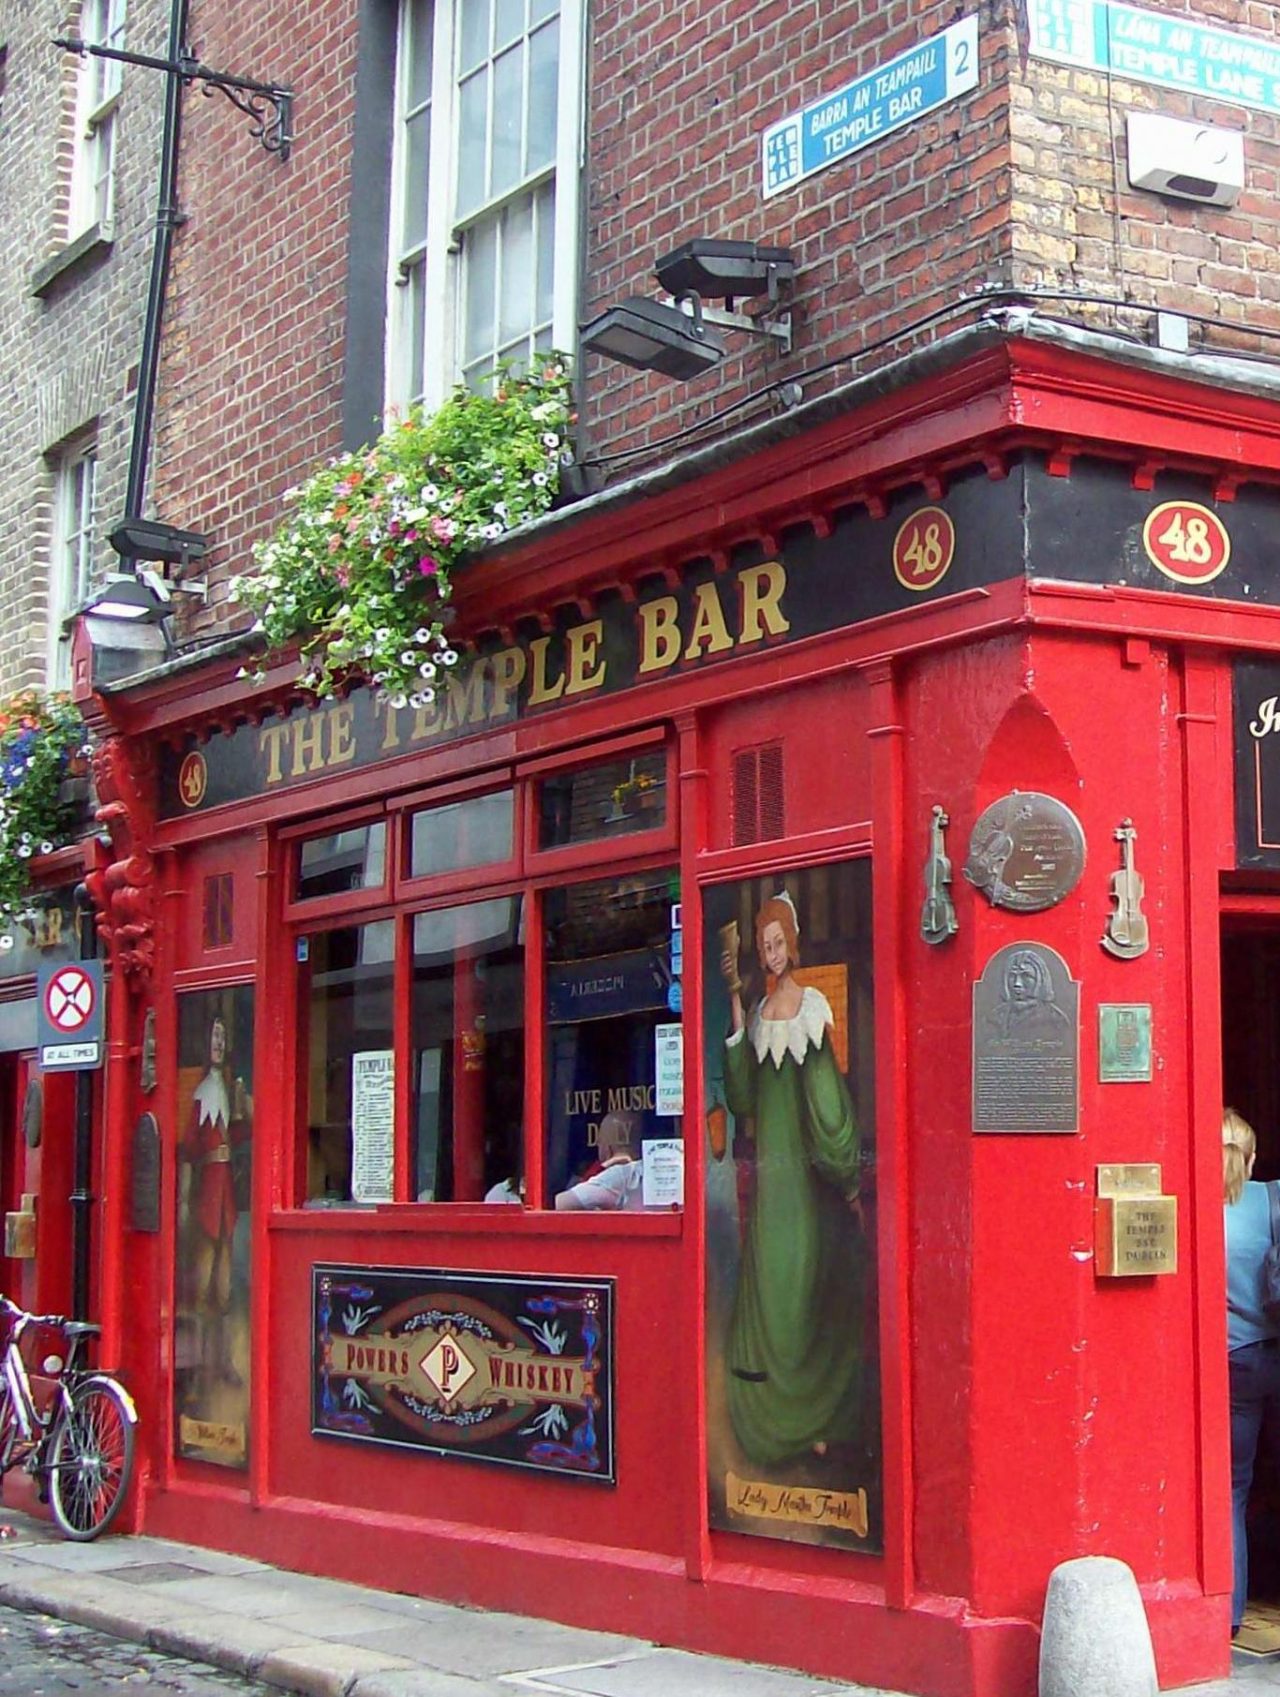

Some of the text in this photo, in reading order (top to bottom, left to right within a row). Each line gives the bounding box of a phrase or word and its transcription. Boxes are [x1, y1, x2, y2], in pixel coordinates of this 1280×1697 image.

[954, 40, 969, 77] 2
[1169, 28, 1193, 53] AN
[810, 48, 937, 137] BARRA AN TEAMPAILL
[1112, 43, 1199, 81] TEMPLE
[1206, 65, 1265, 97] LANE
[823, 86, 923, 156] TEMPLE BAR
[903, 523, 943, 577] 48
[1158, 511, 1213, 565] 48
[260, 560, 791, 785] THE TEMPLE BAR
[58, 1049, 71, 1059] ALL
[73, 1047, 95, 1058] TIMES
[565, 1085, 656, 1115] LIVE MUSIC
[348, 1343, 410, 1375] POWERS
[488, 1355, 573, 1394] WHISKEY
